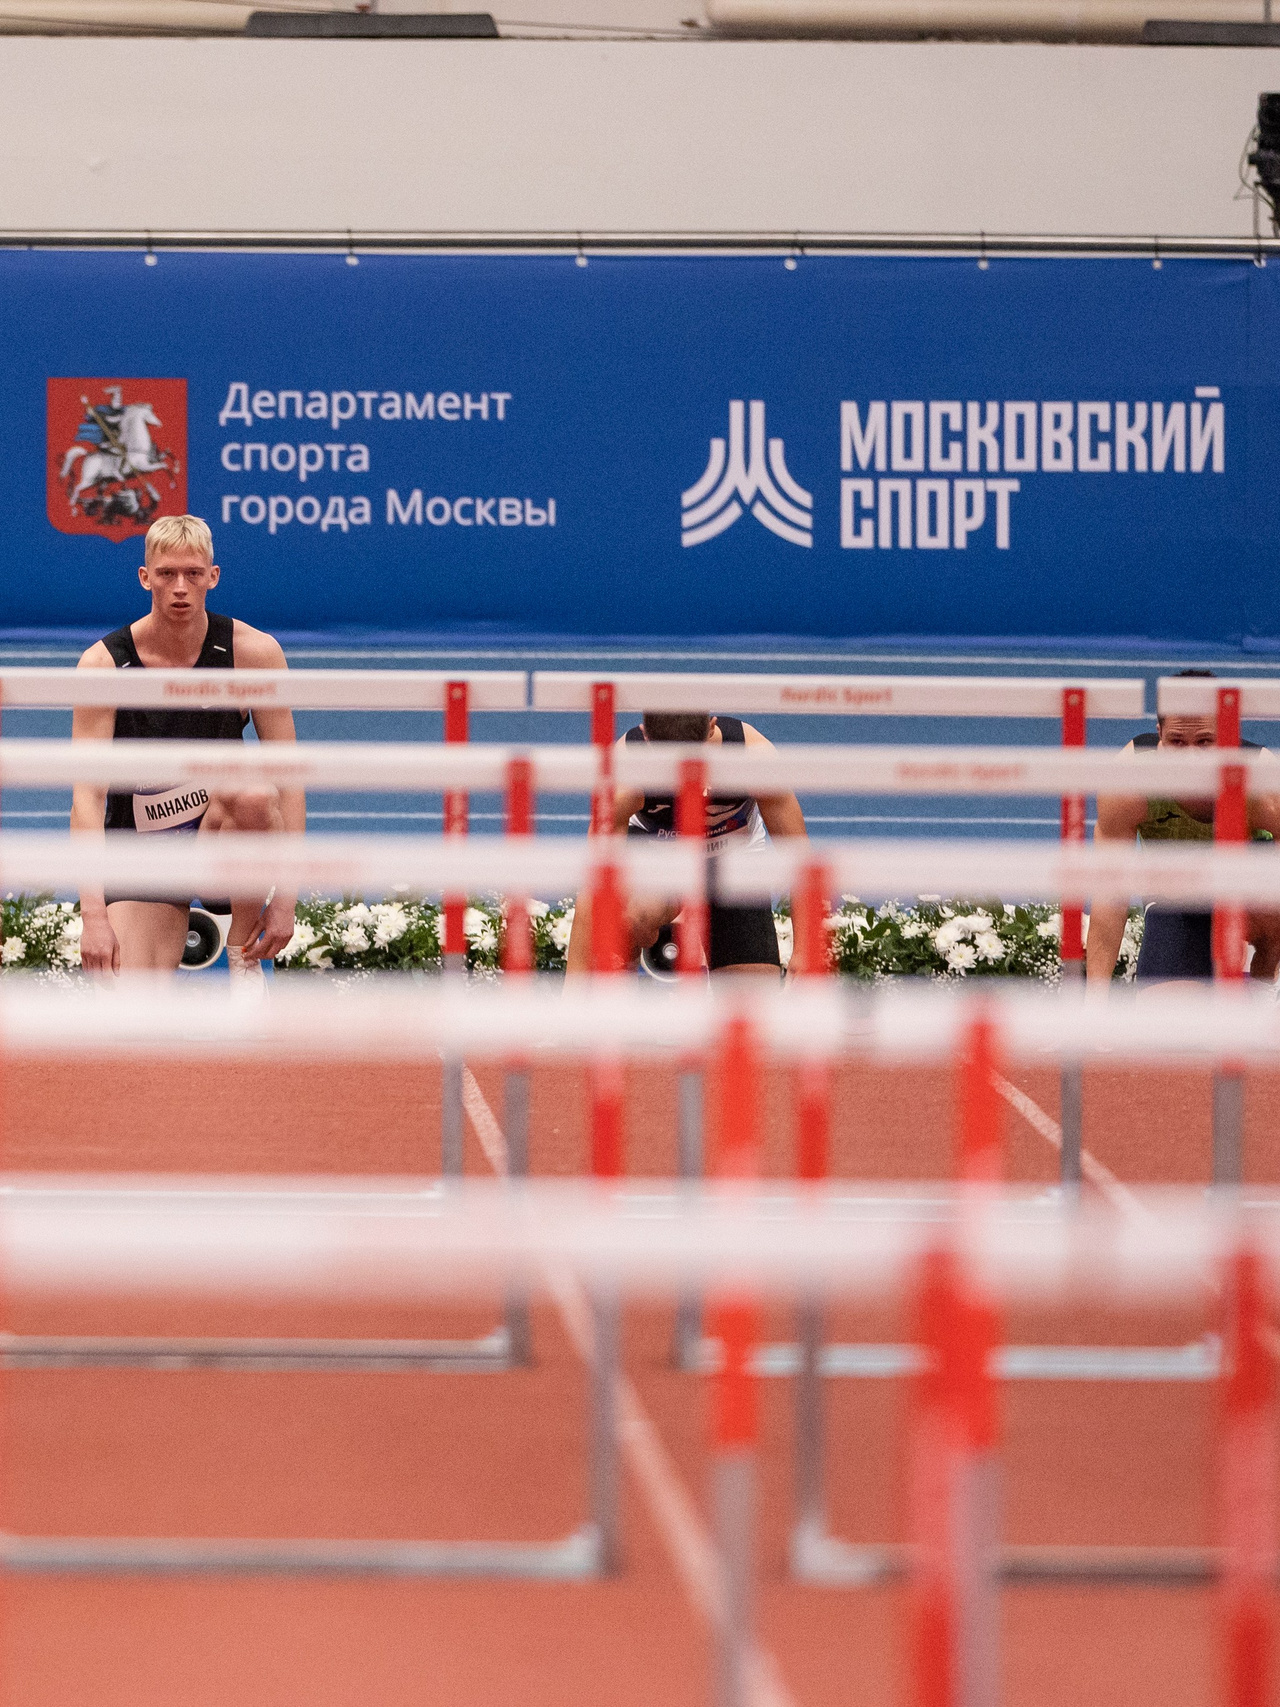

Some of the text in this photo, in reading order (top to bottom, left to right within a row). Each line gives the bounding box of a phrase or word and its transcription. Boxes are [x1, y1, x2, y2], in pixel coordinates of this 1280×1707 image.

[219, 383, 512, 429] Департамент
[840, 386, 1225, 473] МОСКОВСКИЙ
[221, 442, 370, 482] спорта
[221, 490, 557, 534] города Москвы
[840, 478, 1020, 549] СПОРТ
[144, 788, 209, 821] МАНАКОВ
